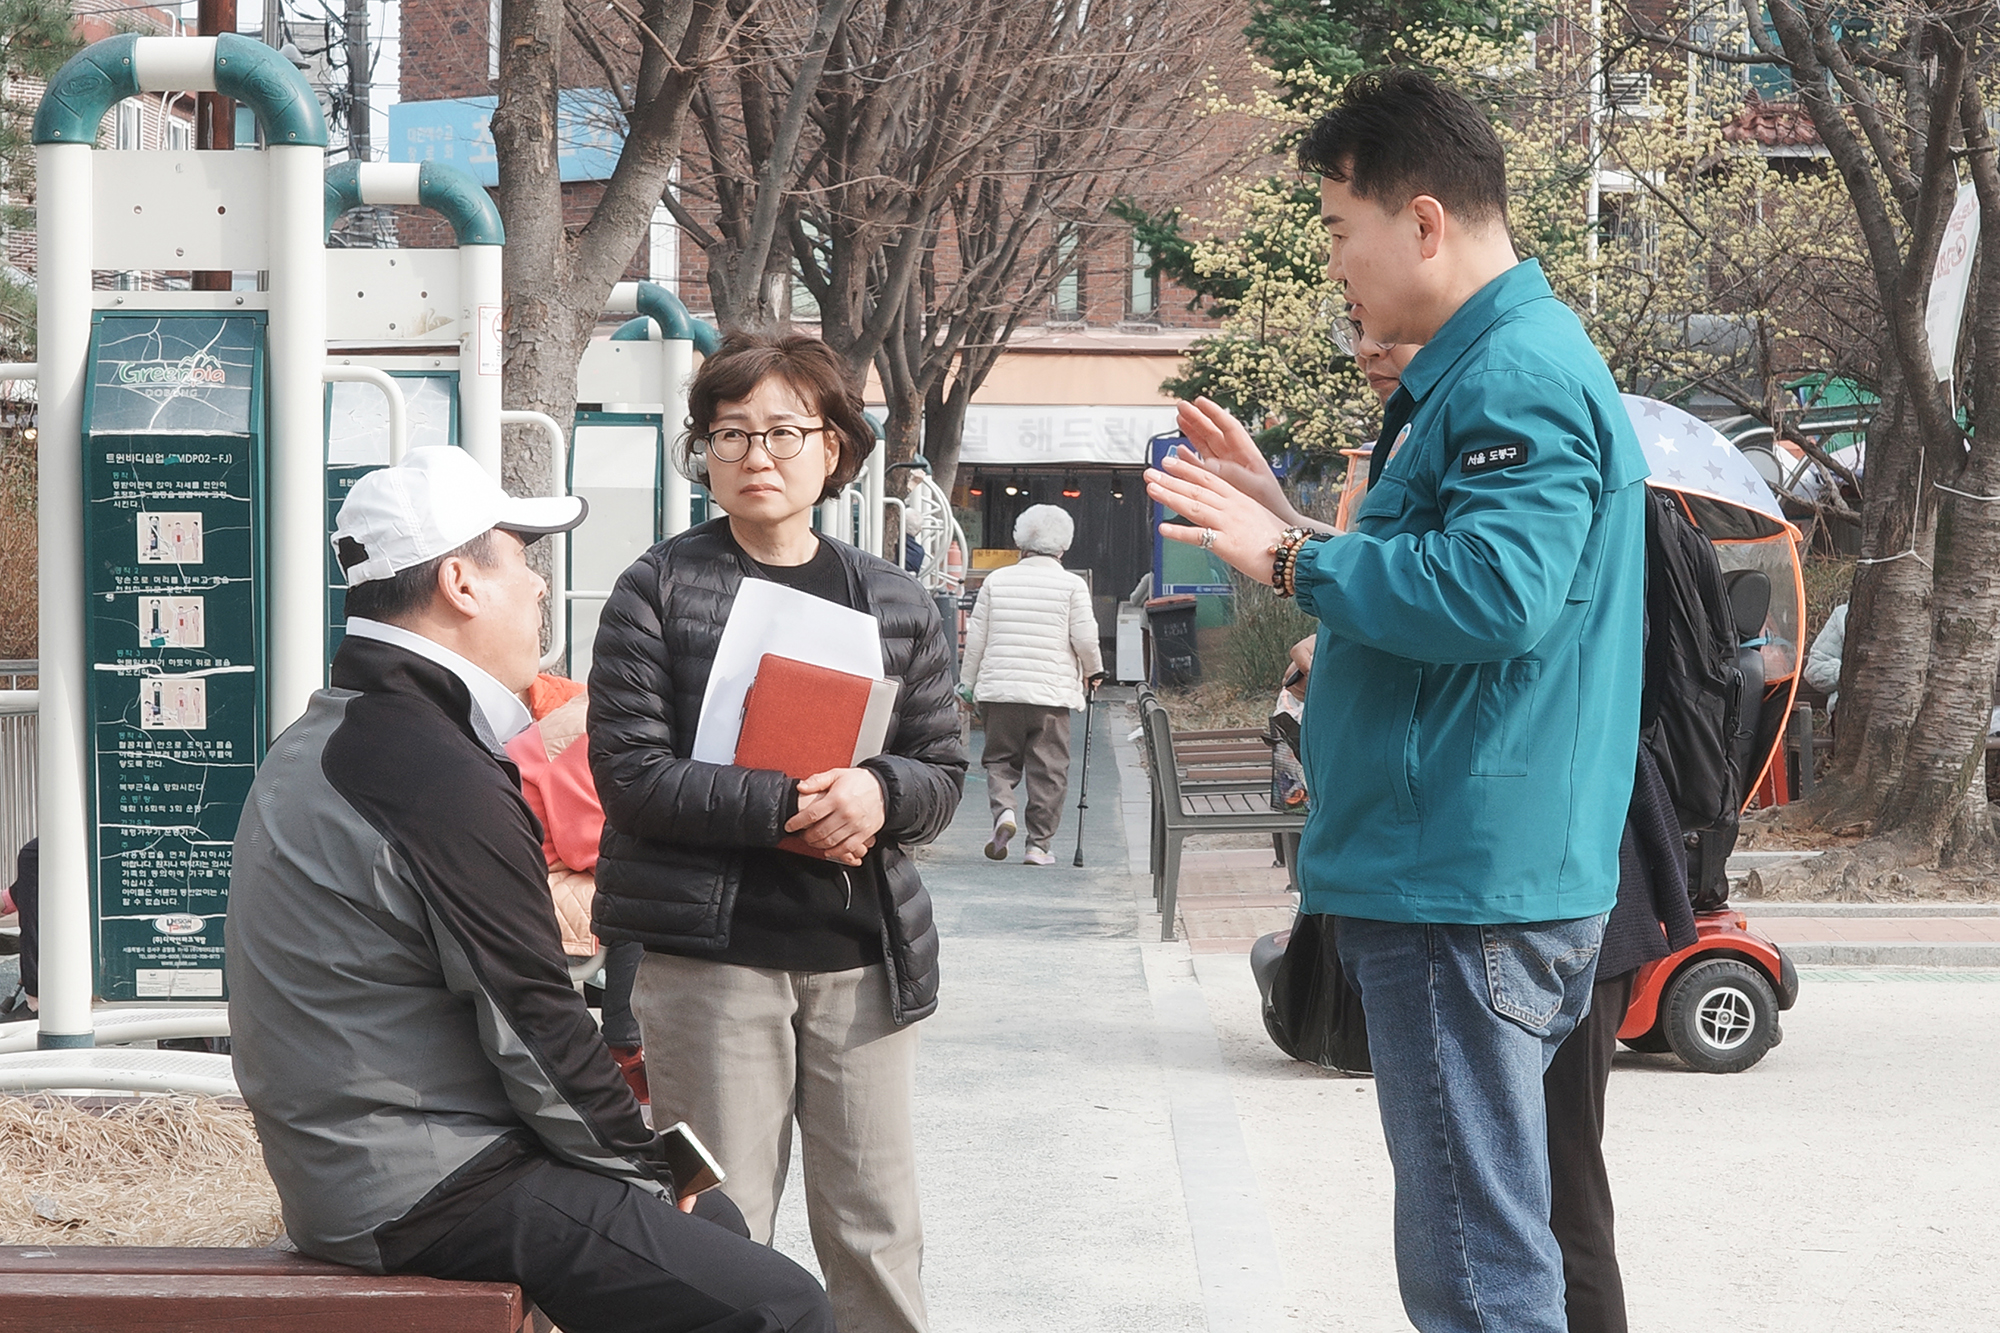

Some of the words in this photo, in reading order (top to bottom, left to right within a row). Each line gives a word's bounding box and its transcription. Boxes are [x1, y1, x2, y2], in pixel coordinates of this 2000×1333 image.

[118, 362, 226, 386] Greenpia
[145, 389, 198, 397] DOBONG
[1467, 452, 1486, 466] 서울
[1489, 447, 1517, 461] 도봉구
[175, 481, 200, 489] 자세를
[115, 576, 149, 584] 양손으로
[119, 741, 152, 749] 팔꿈치를
[156, 741, 182, 749] 안으로
[122, 879, 158, 887] 하십시오.
